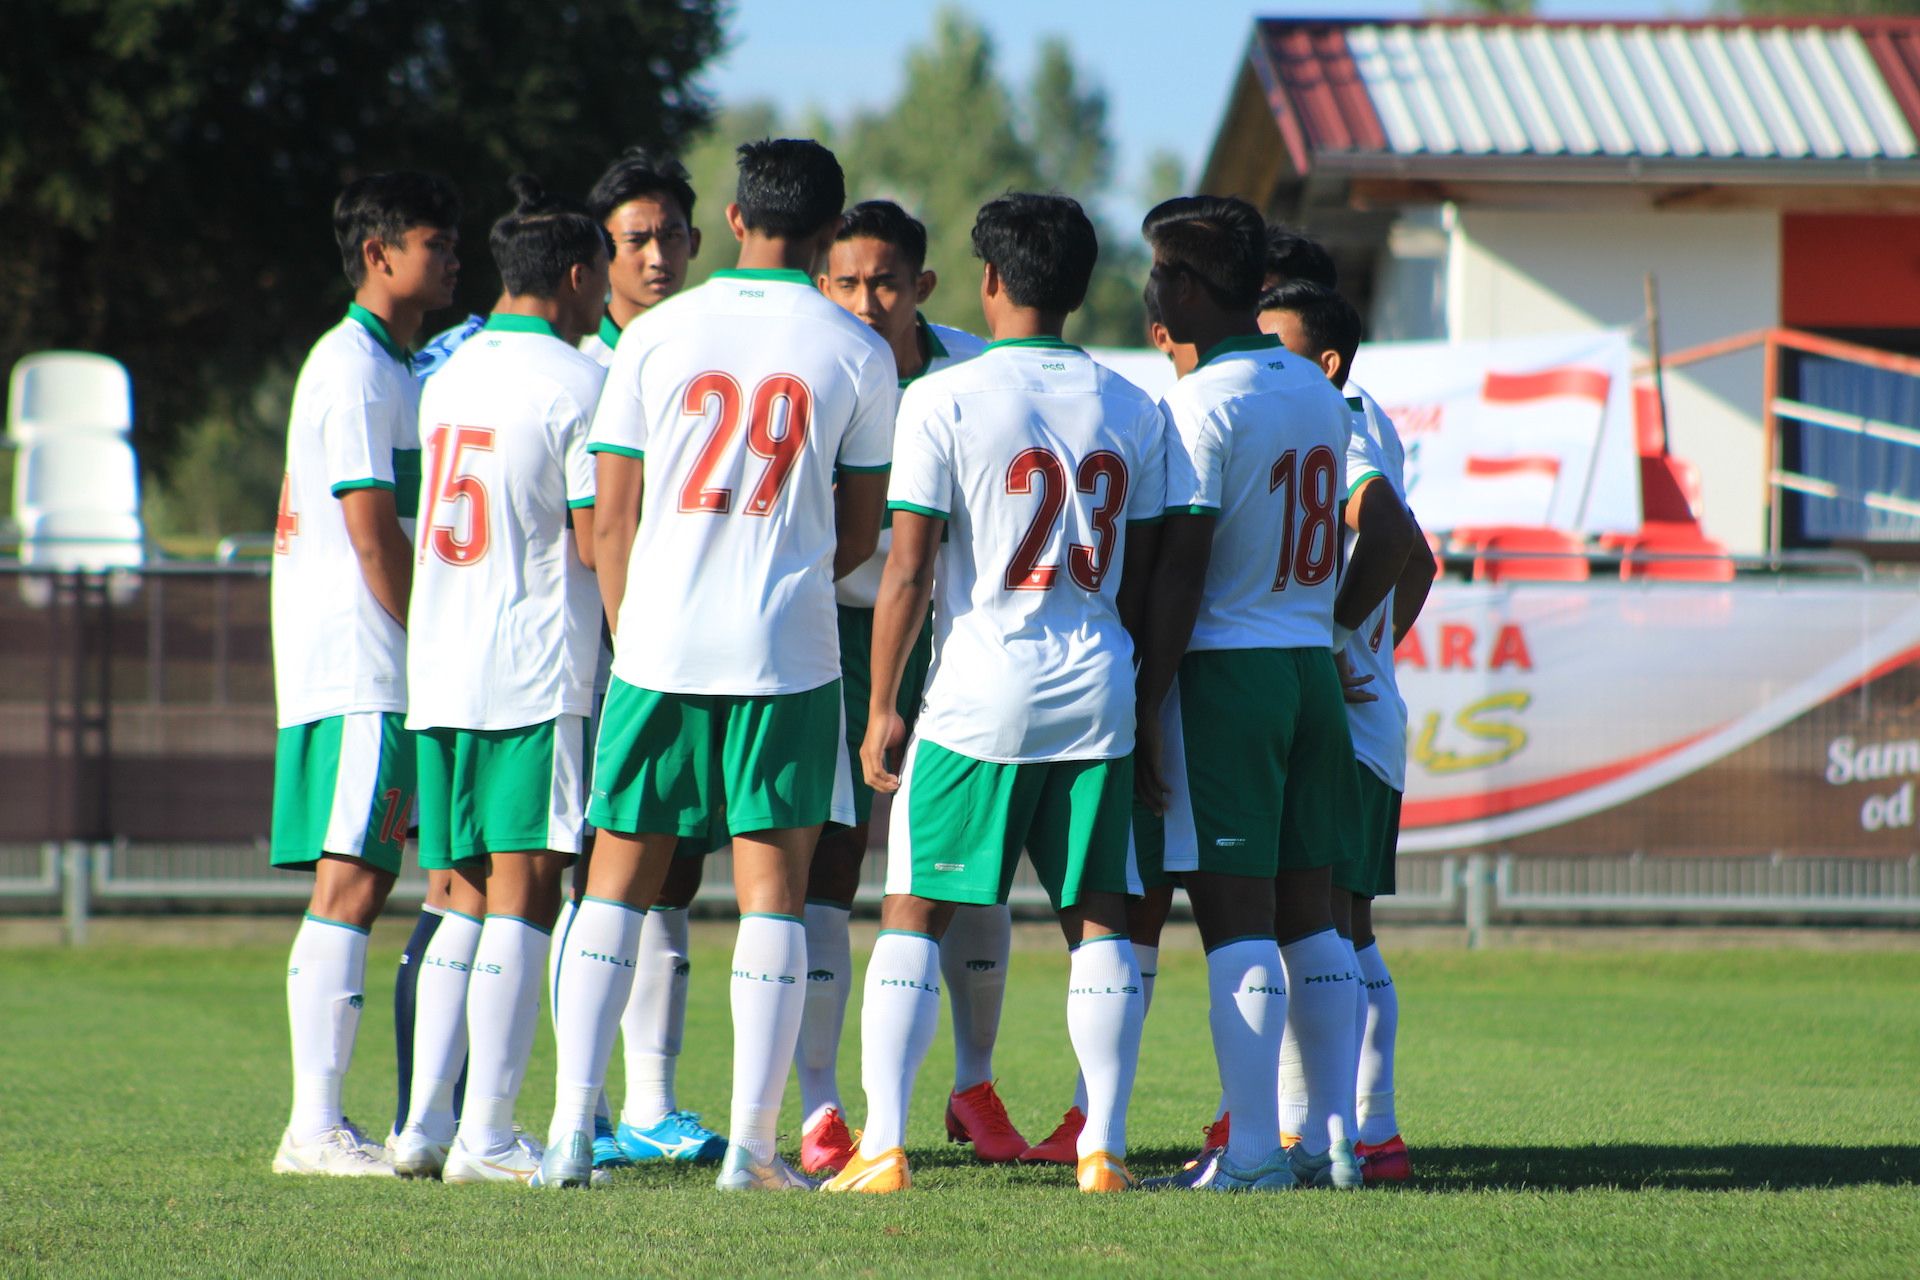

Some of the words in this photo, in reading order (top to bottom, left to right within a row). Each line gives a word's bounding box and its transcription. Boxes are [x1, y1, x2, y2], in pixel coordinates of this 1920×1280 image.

[677, 370, 813, 517] 29
[418, 423, 496, 566] 15
[1004, 446, 1129, 593] 23
[1269, 445, 1337, 592] 18
[1826, 737, 1920, 785] Sam
[381, 788, 413, 848] 14
[1861, 782, 1914, 831] od
[580, 950, 637, 968] MILL
[1069, 986, 1139, 995] MILLS
